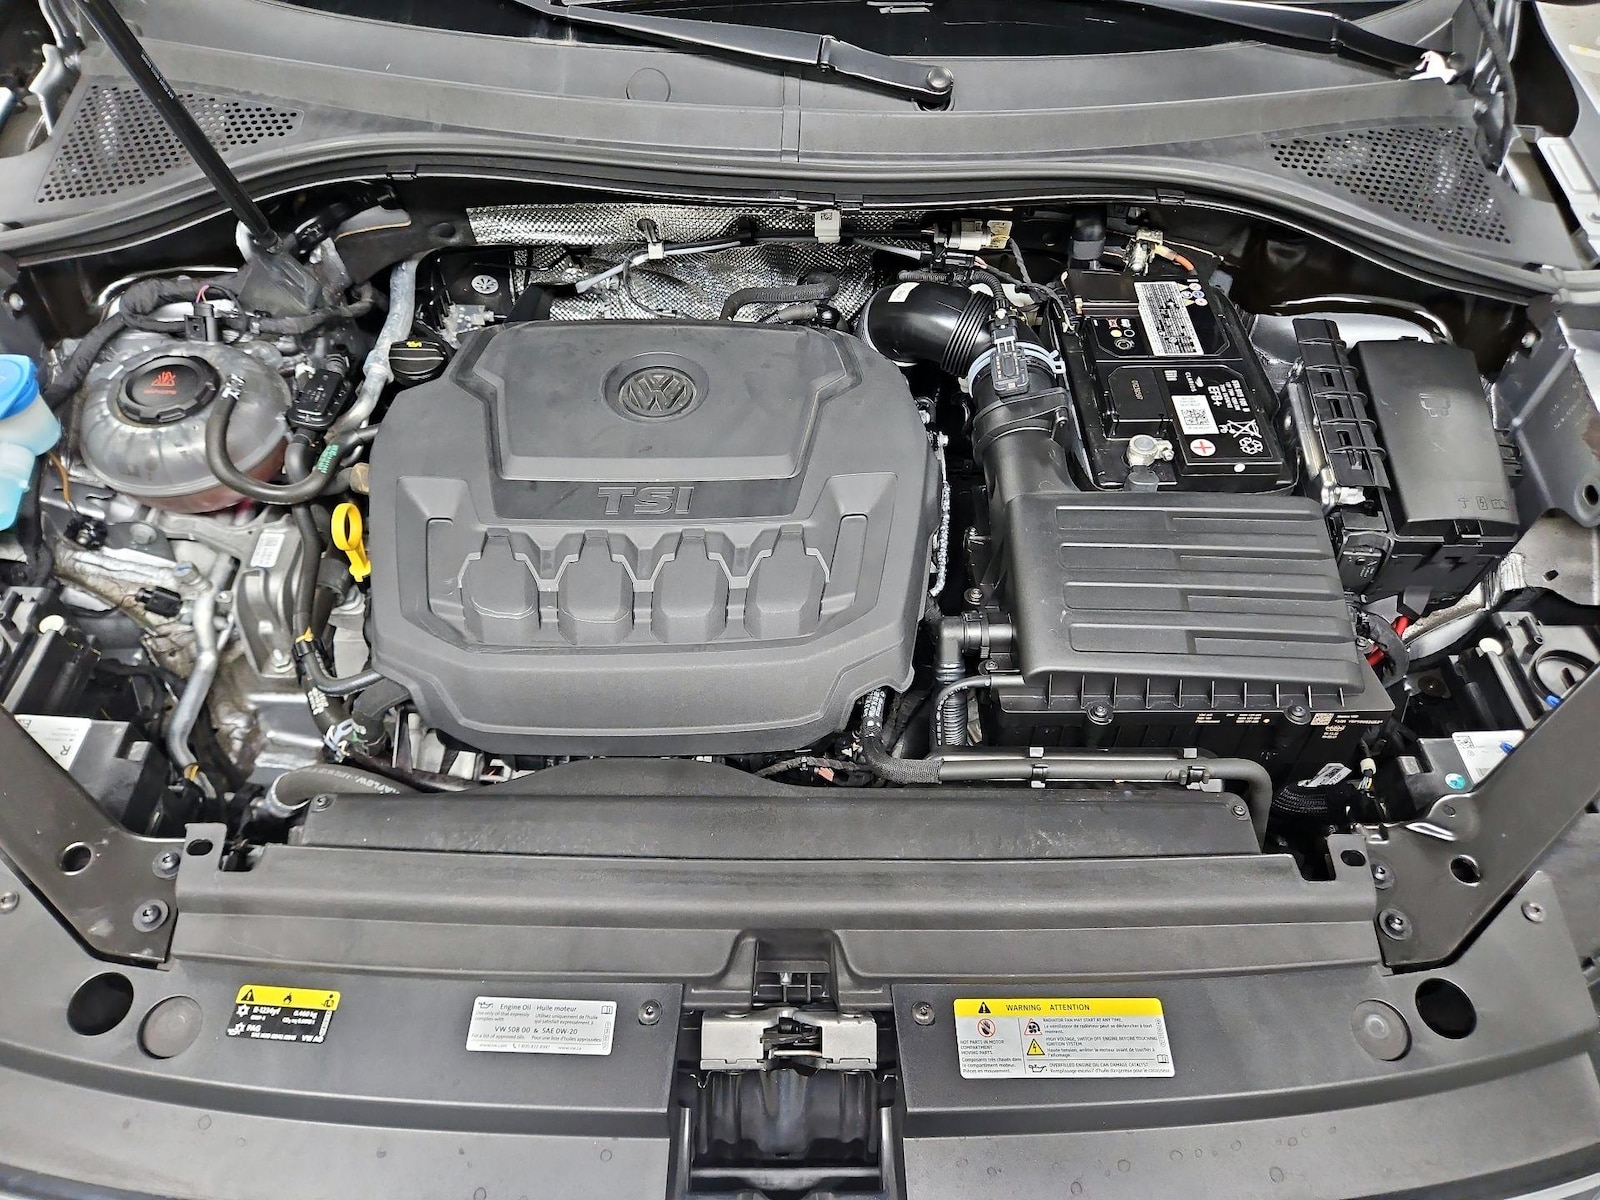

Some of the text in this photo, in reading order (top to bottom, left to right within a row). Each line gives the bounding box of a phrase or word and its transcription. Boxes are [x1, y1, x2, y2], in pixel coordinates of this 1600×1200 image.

[1207, 385, 1223, 406] EFB+
[598, 486, 694, 514] TSI
[246, 1024, 261, 1032] PAG
